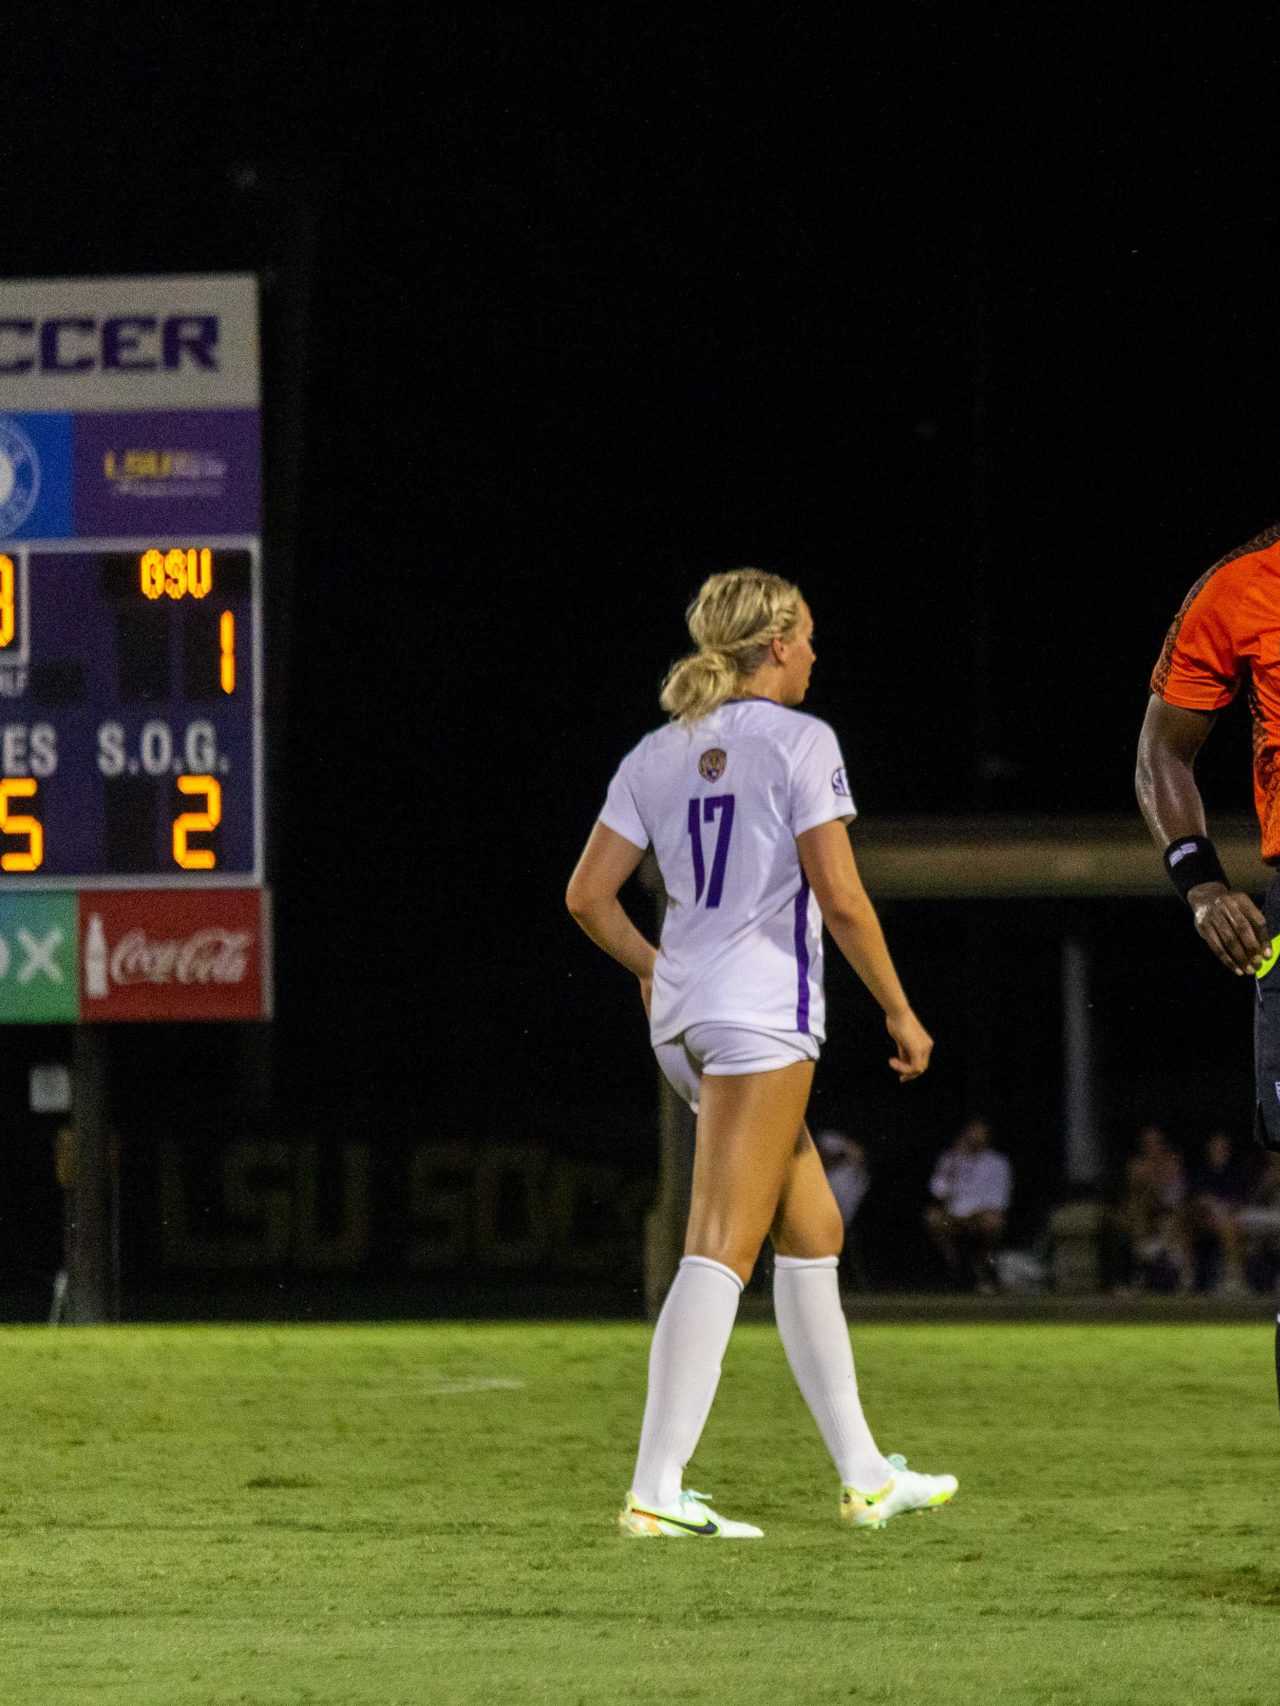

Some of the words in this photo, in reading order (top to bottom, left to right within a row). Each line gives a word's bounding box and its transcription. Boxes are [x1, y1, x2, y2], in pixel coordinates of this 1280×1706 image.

[141, 548, 212, 600] GSU
[219, 610, 236, 695] 1
[97, 718, 230, 776] S.O.G.
[0, 777, 43, 871] 5
[173, 775, 222, 870] 2
[688, 794, 735, 910] 17
